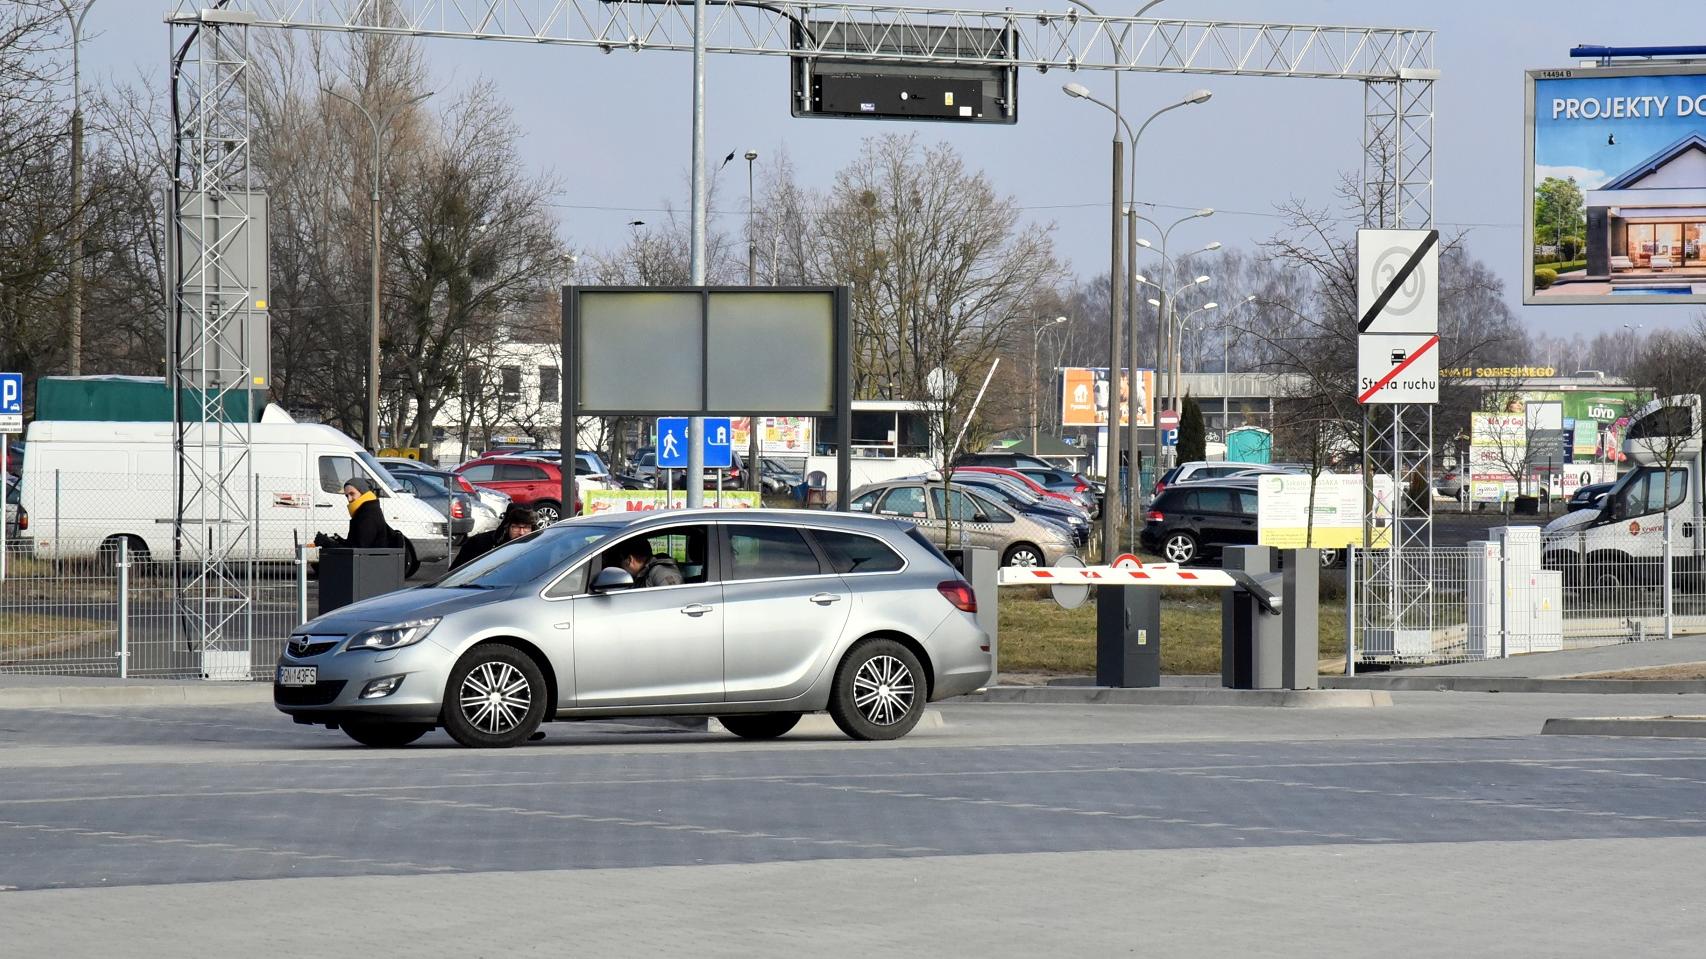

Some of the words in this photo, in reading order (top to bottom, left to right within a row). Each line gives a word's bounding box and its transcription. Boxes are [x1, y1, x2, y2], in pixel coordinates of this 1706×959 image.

[1552, 95, 1669, 119] PROJEKTY
[1361, 377, 1398, 390] Stfa
[1403, 377, 1436, 390] ruchu
[3, 380, 17, 409] P
[1588, 405, 1615, 419] LOYD
